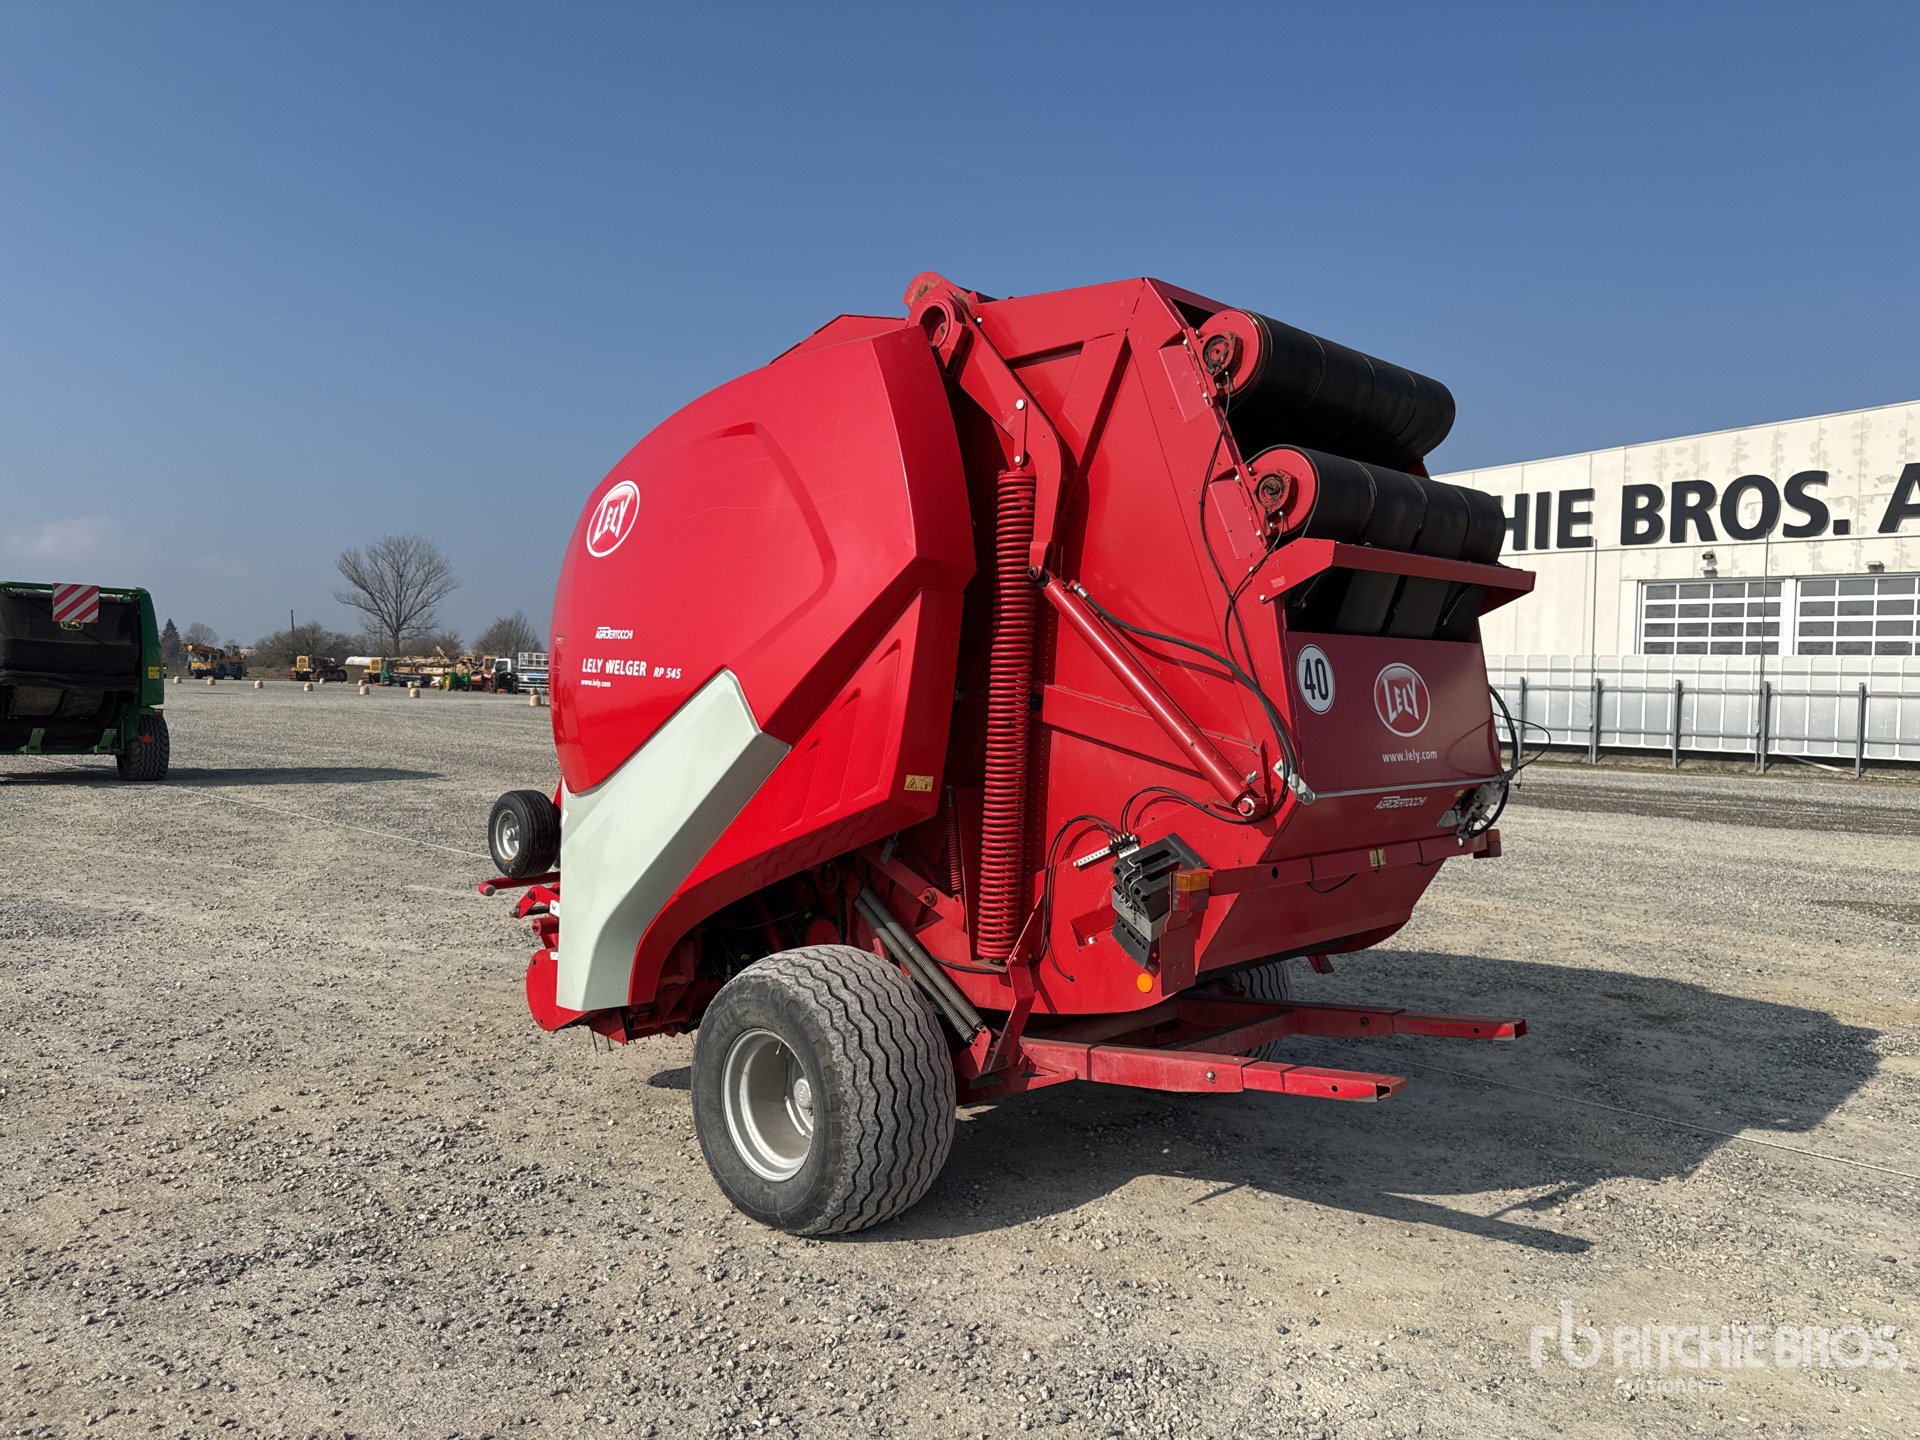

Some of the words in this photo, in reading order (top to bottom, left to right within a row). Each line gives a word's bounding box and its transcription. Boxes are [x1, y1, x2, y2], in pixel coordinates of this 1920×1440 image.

[592, 493, 632, 545] LELY
[1620, 470, 1851, 545] BROS.
[580, 679, 612, 688] www.lely.com
[582, 658, 603, 673] LELY
[605, 659, 647, 677] WELGER
[653, 667, 664, 678] RP
[665, 667, 682, 680] 545
[1304, 658, 1329, 701] 40
[1383, 677, 1420, 724] LELY
[1382, 749, 1438, 763] www.lely.com
